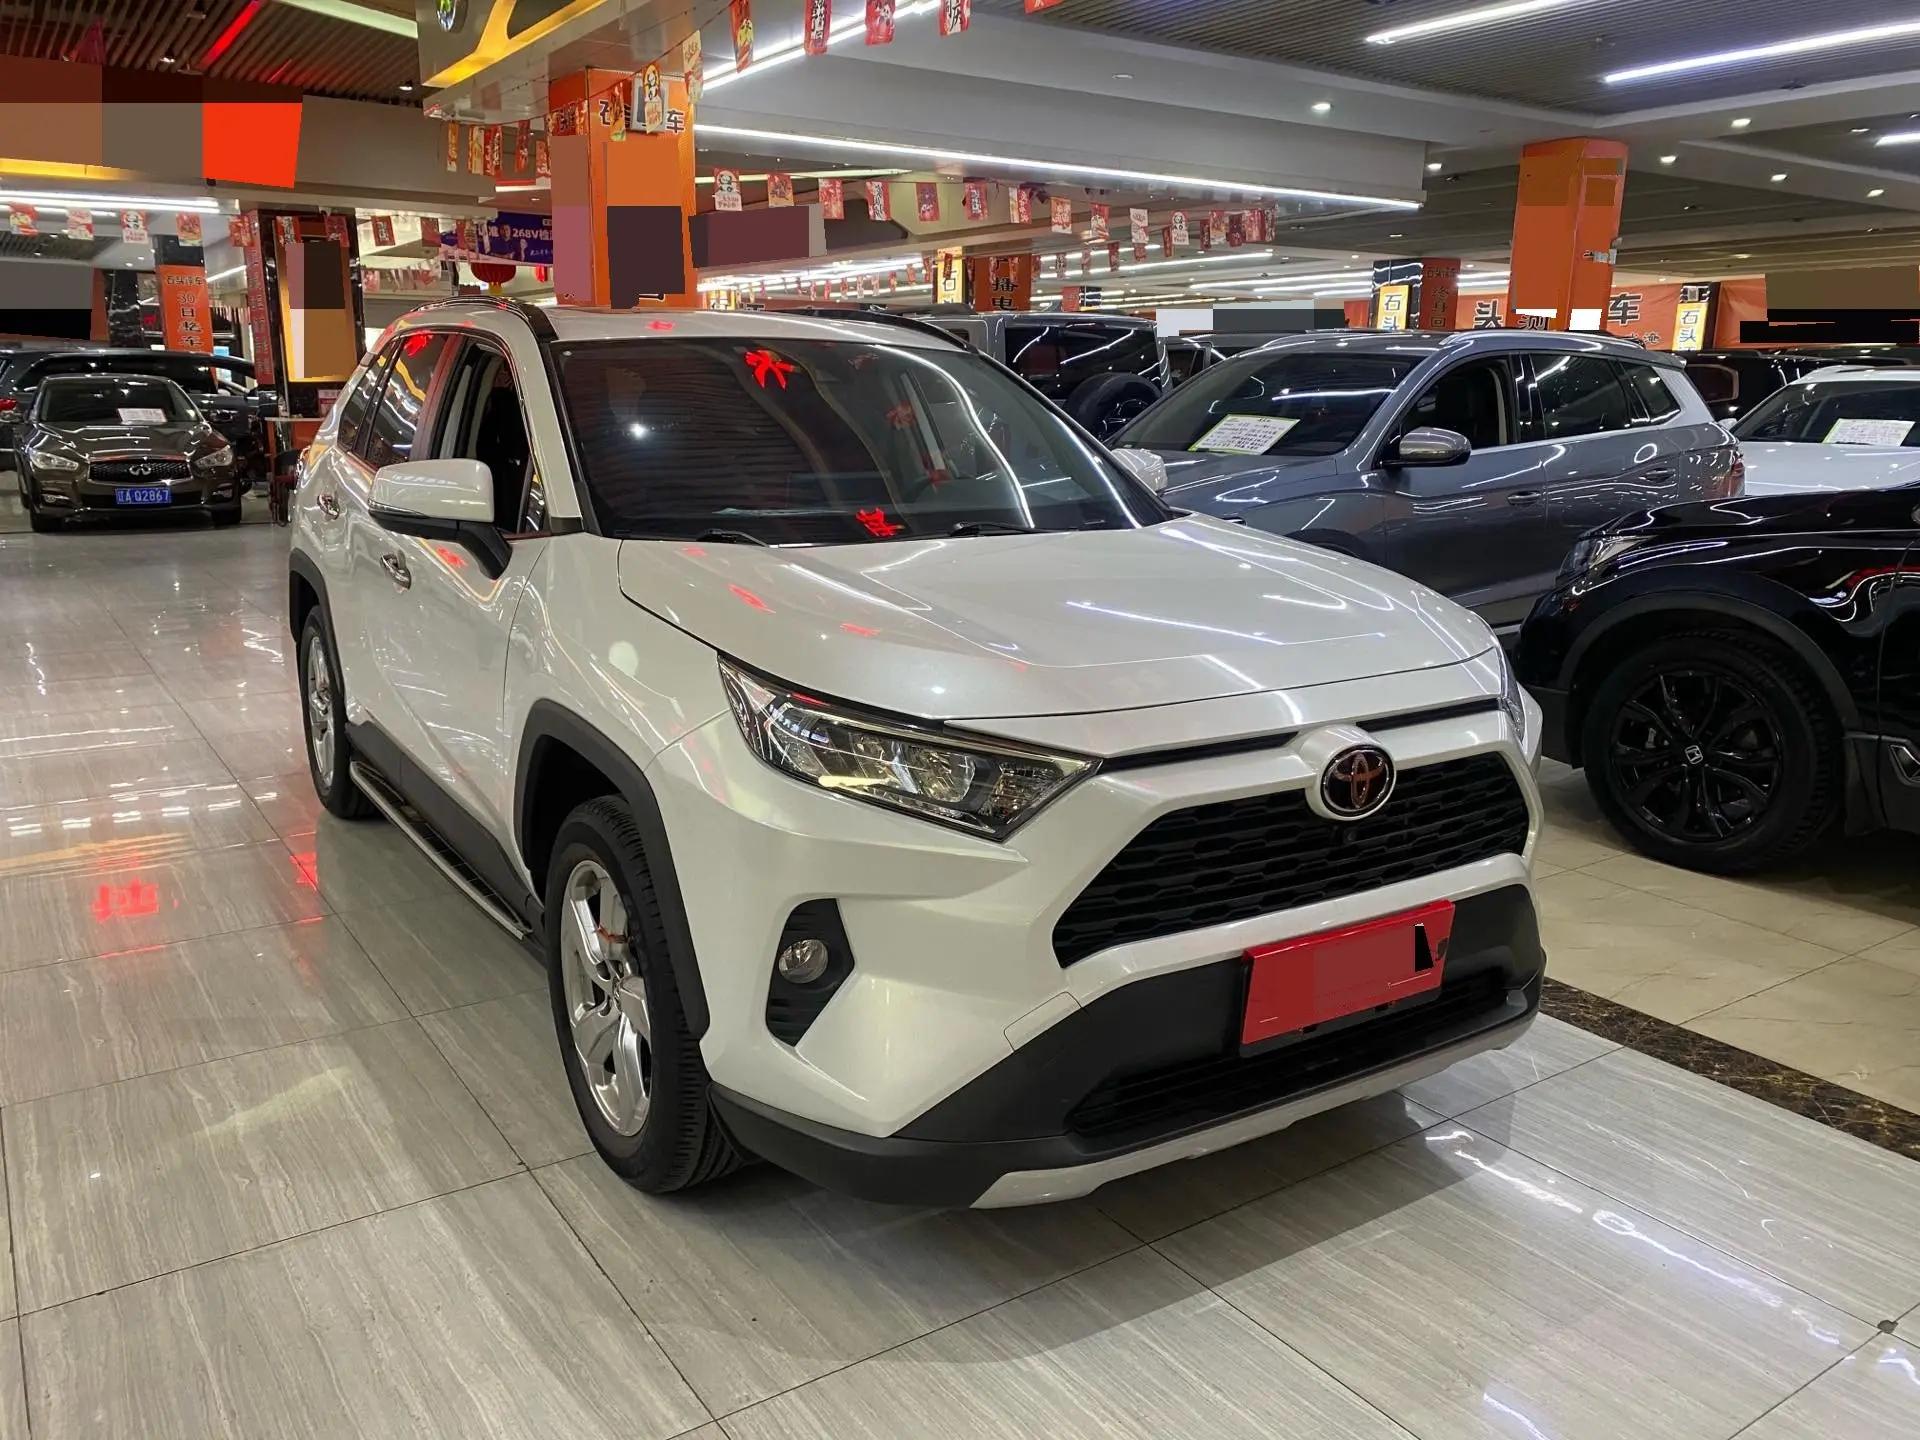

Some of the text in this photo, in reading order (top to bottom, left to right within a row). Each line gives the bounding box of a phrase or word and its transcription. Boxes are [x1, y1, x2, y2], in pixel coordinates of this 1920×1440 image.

[512, 228, 553, 240] 268V检
[1608, 292, 1642, 326] 车
[1679, 308, 1699, 351] 石头
